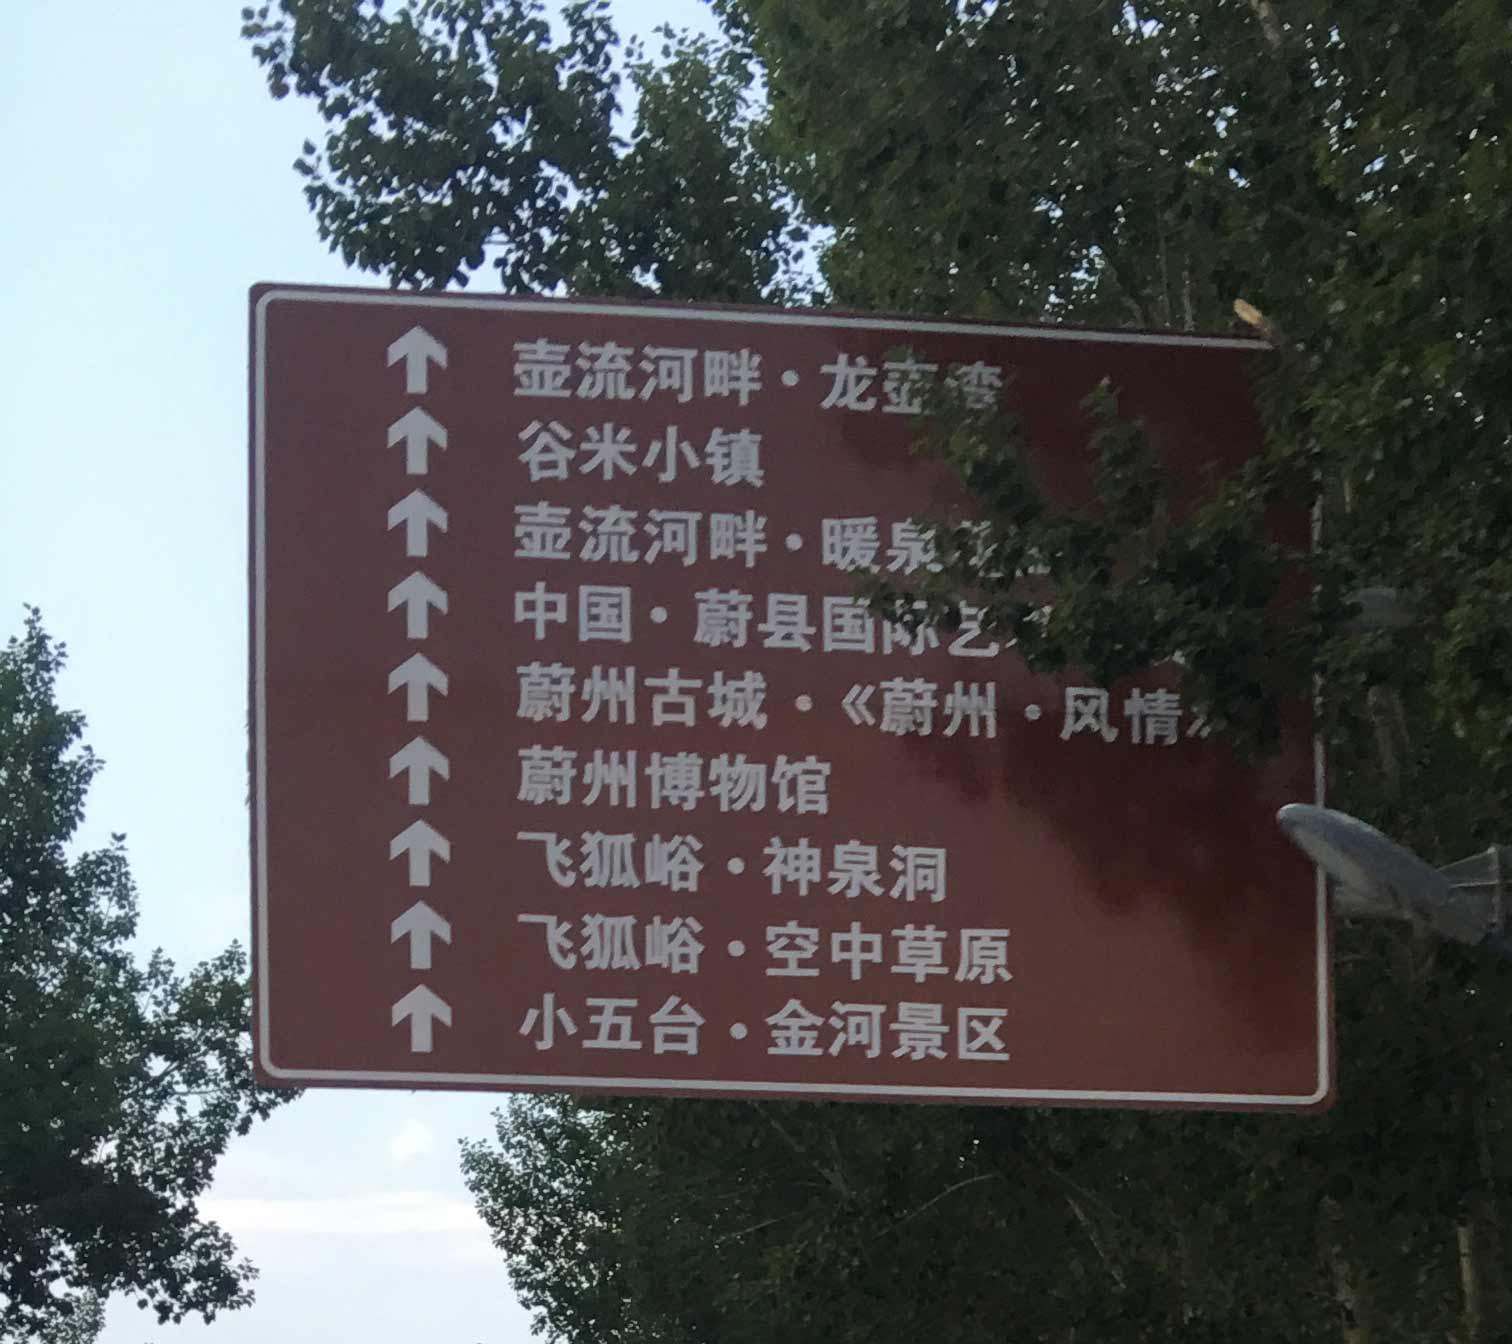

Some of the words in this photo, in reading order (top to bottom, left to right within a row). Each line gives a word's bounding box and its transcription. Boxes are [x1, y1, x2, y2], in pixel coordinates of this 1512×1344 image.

[517, 420, 765, 488] 谷米小镇
[513, 500, 1053, 578] 壶流河畔·暖泉
[516, 744, 832, 815] 蔚州博物馆
[516, 829, 948, 903] 飞狐峪·神泉洞
[516, 912, 1014, 985] 飞狐峪·空中草原
[518, 992, 1011, 1062] 小五台·金河景区
